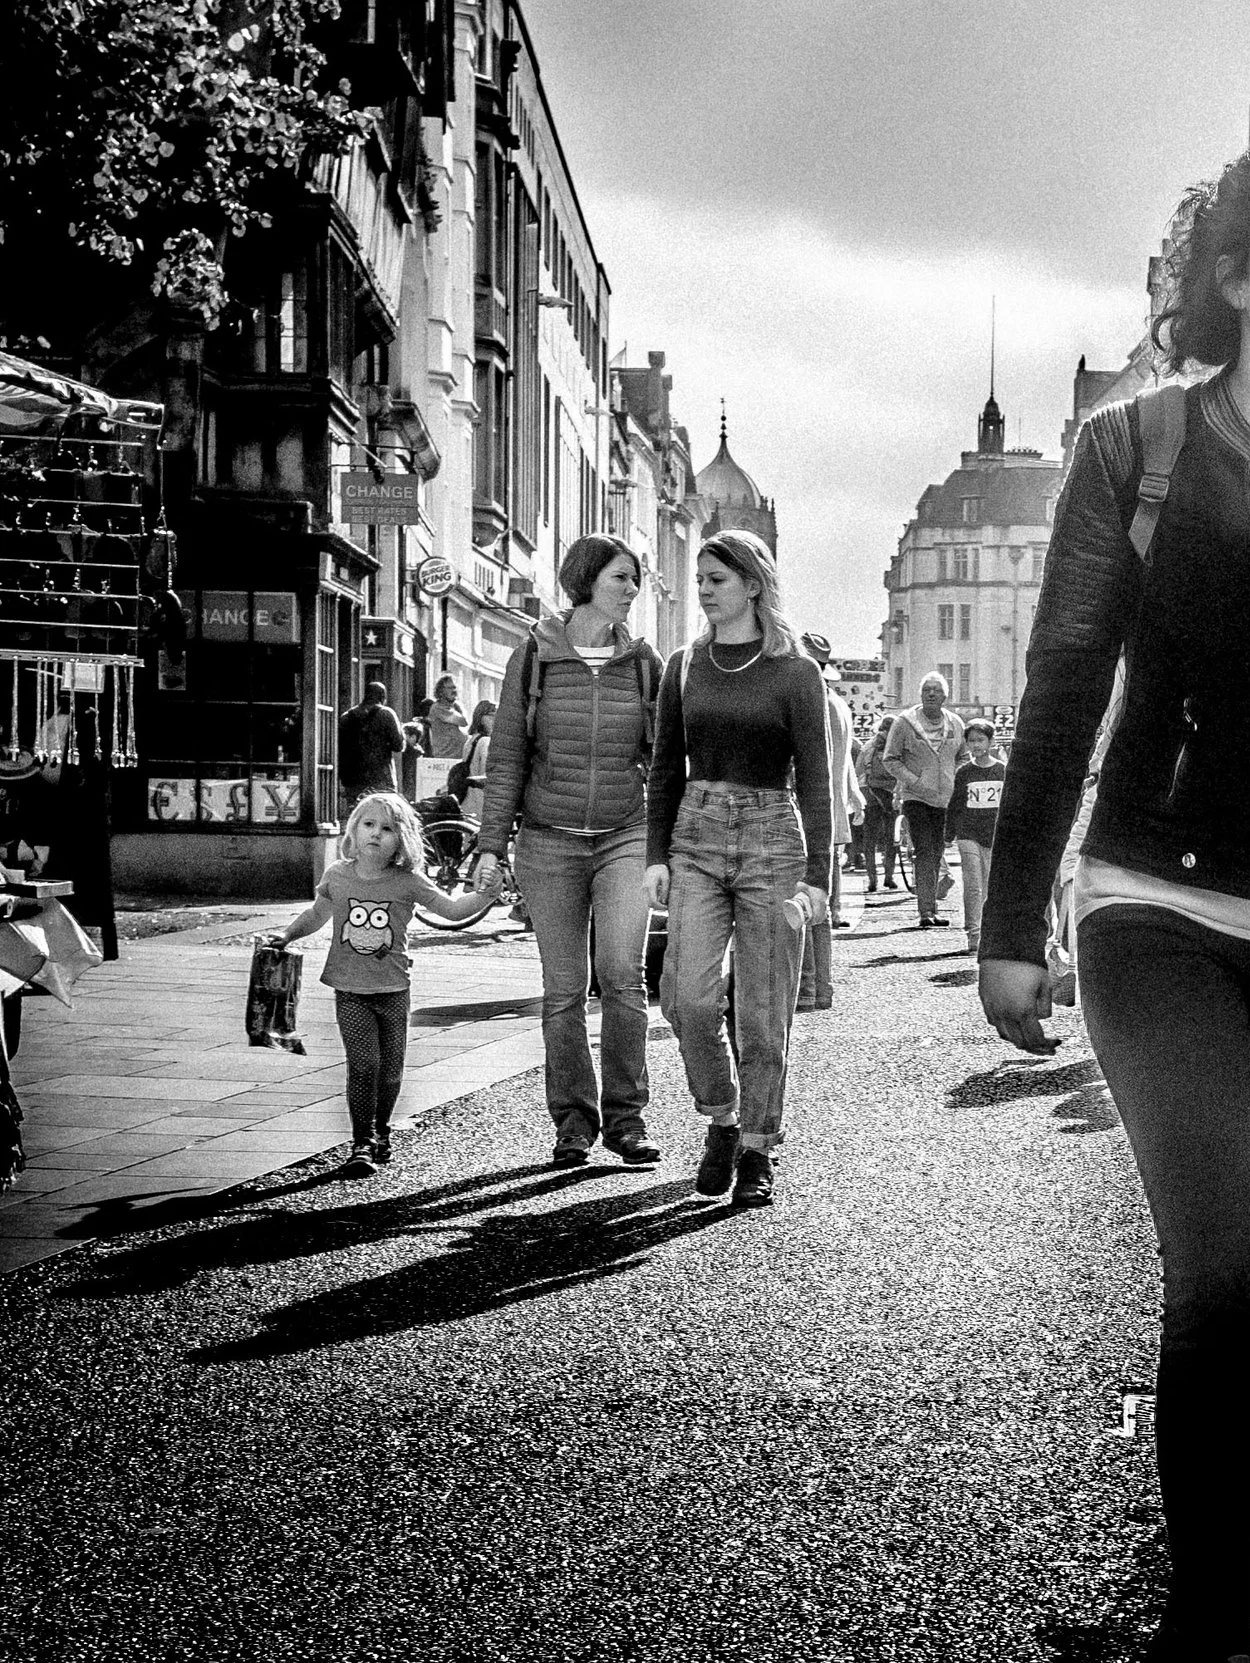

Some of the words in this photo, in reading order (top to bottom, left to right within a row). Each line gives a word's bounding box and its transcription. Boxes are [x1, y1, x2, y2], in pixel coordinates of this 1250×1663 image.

[345, 484, 414, 499] CHANGE
[421, 564, 451, 579] BURGER
[422, 571, 452, 587] KING
